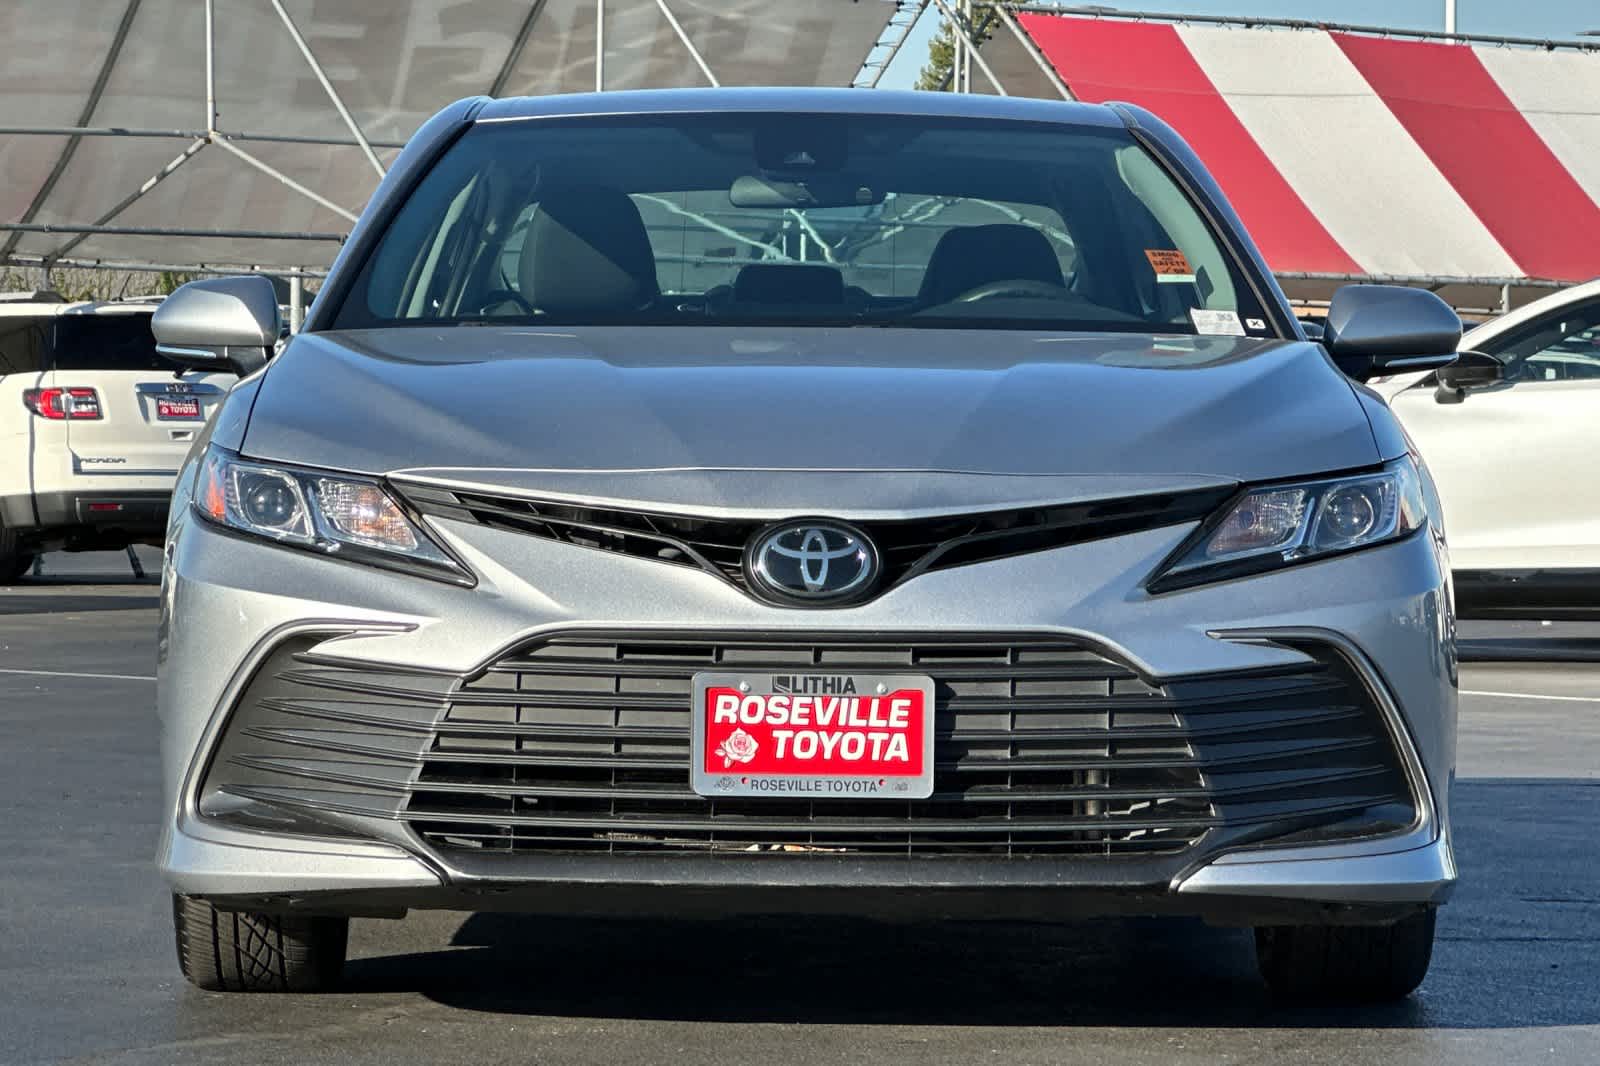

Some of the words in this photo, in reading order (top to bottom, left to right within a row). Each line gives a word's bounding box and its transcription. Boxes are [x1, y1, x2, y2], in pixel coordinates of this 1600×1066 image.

[170, 406, 197, 414] TOYOTA
[791, 676, 857, 695] LITHIA
[714, 695, 912, 728] ROSEVILLE
[772, 730, 910, 762] TOYOTA
[750, 779, 822, 792] ROSEVILLE
[826, 780, 878, 793] TOYOTA
